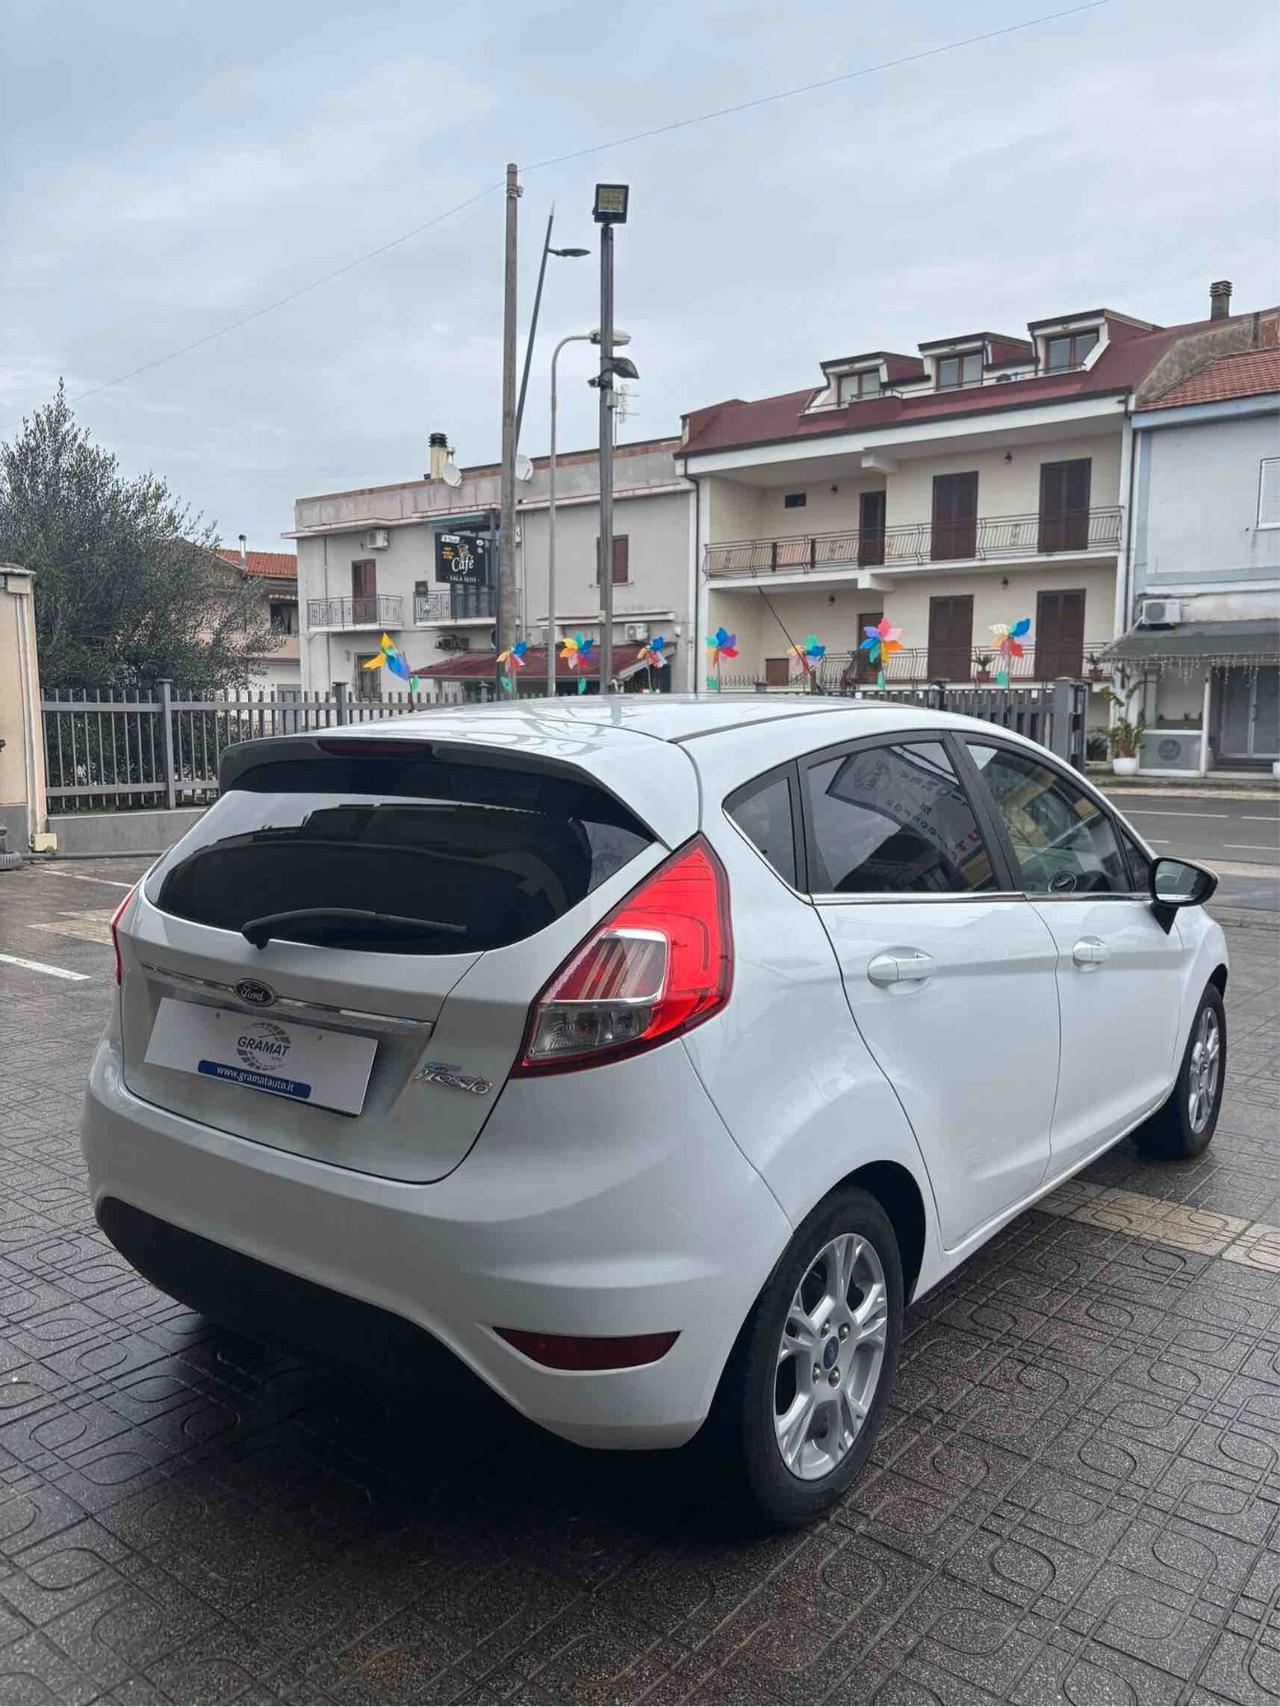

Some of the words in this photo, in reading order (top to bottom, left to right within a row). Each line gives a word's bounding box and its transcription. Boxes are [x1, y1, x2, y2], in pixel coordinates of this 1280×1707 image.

[452, 554, 475, 575] Café
[240, 984, 264, 1001] Ford
[237, 1036, 291, 1057] GRAMAT
[216, 1066, 295, 1093] www.gramatauto.it
